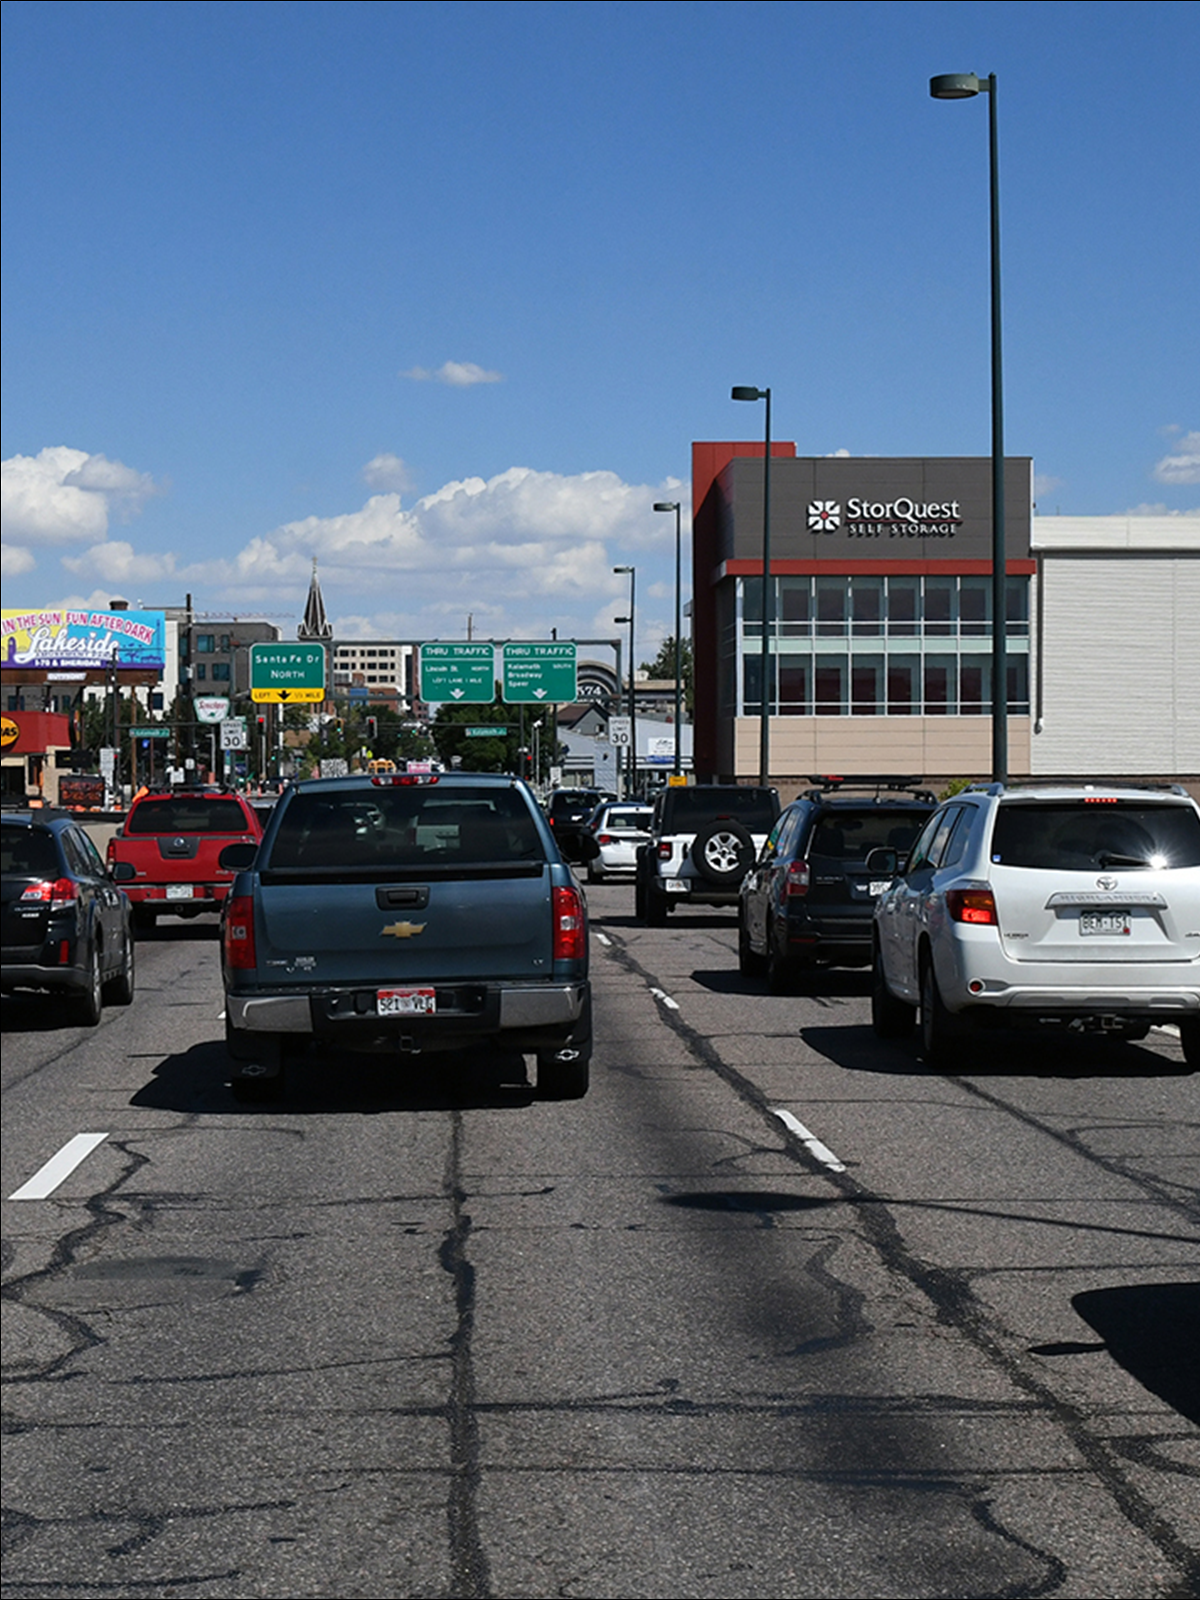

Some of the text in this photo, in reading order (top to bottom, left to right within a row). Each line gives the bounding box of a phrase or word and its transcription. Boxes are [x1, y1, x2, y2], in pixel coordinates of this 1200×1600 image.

[847, 497, 961, 523] StorQuest
[850, 523, 957, 534] SELF STORAGE
[2, 618, 16, 634] IN
[17, 613, 37, 629] THE
[65, 611, 88, 625] FUN
[90, 613, 123, 632] AFTER
[123, 621, 155, 645] DARK
[13, 626, 119, 664] Lakeside
[425, 646, 489, 656] THRU TRAFFIC
[506, 646, 573, 656] THRU TRAFFIC
[60, 659, 101, 667] SHERIDAN
[255, 654, 320, 664] Santa Fe Dr
[270, 669, 305, 679] NORTH
[507, 671, 543, 679] Broadway
[508, 680, 529, 688] Speer
[254, 691, 271, 699] LEFT
[223, 736, 241, 747] 30
[612, 733, 629, 744] 30
